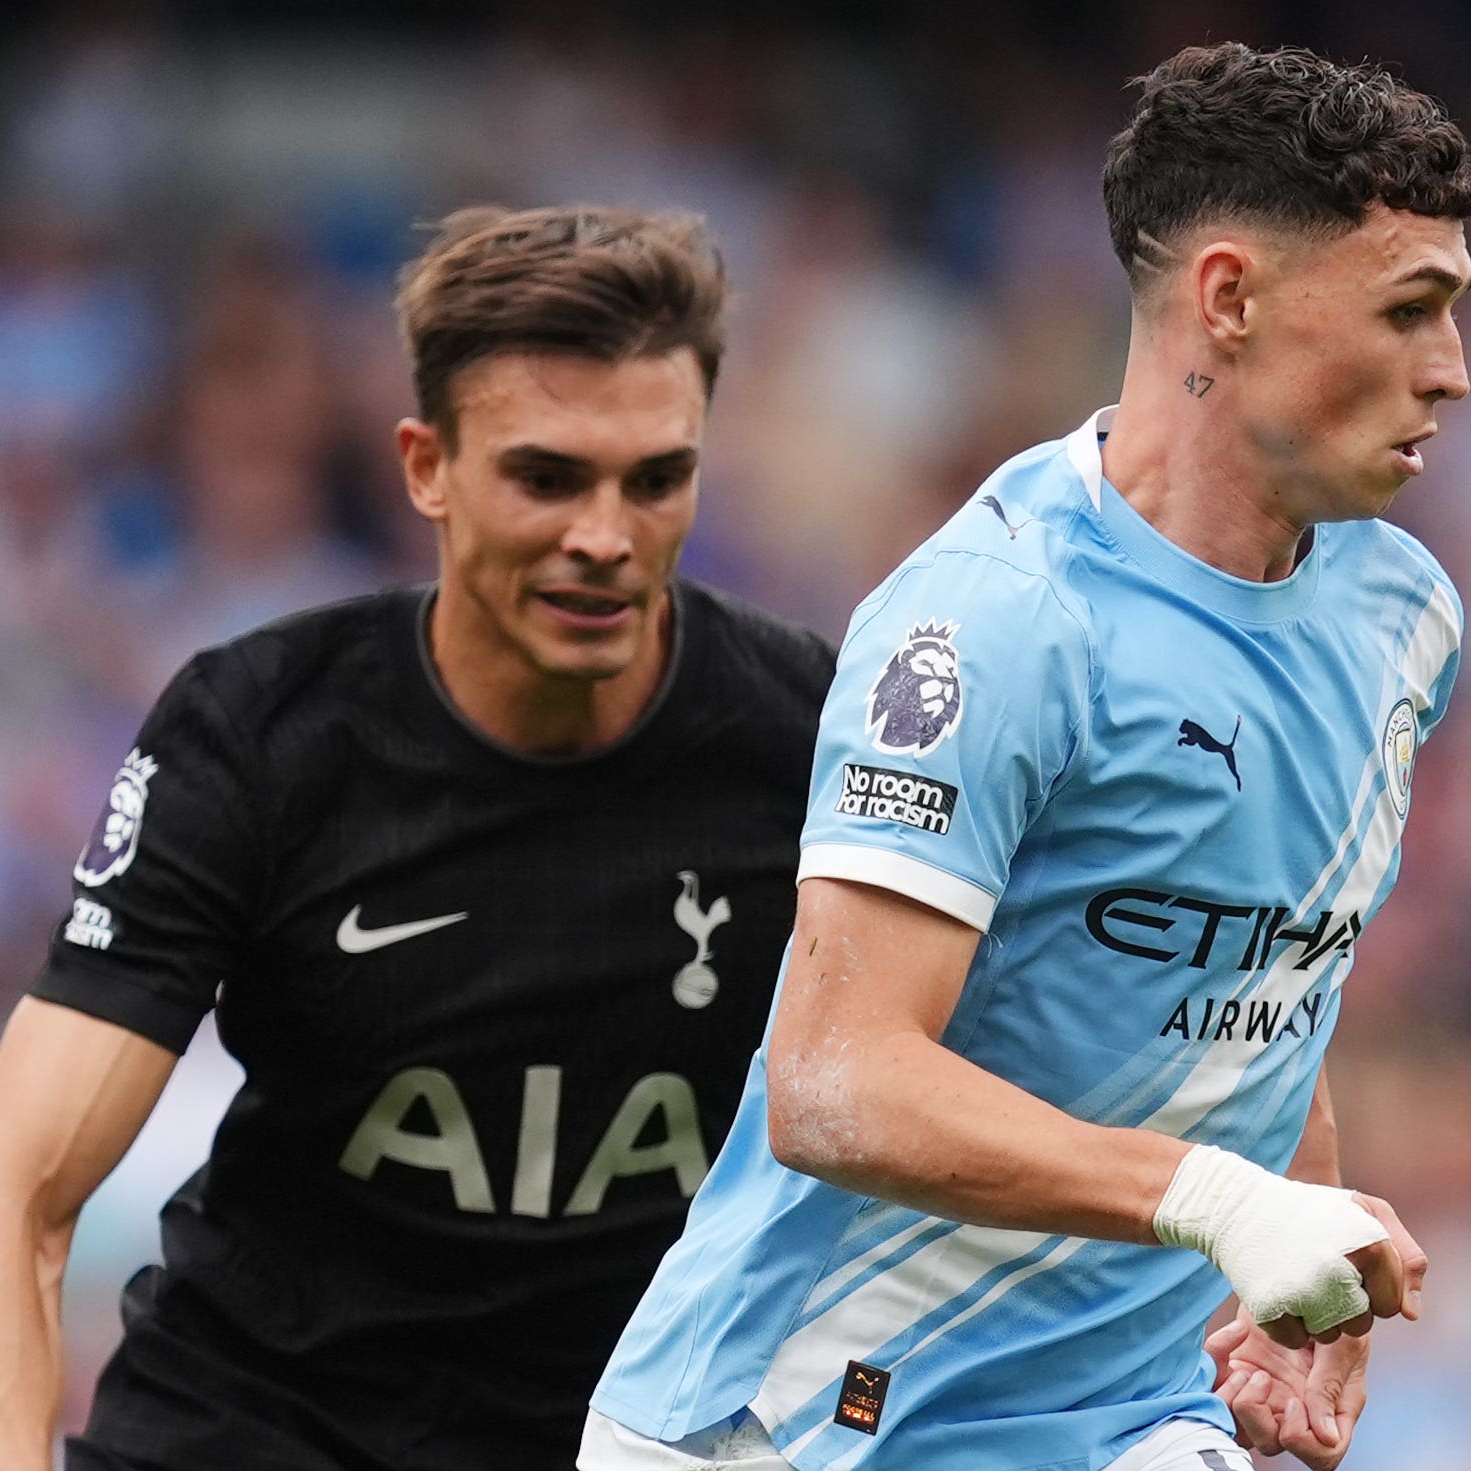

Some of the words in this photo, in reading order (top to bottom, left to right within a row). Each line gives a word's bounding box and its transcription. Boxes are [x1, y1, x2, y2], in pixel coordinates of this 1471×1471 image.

[1184, 371, 1215, 398] 47
[835, 788, 867, 815] for
[865, 796, 950, 834] racism
[843, 765, 870, 793] No
[871, 773, 944, 809] room
[1084, 887, 1362, 971] ETIHA
[1158, 992, 1322, 1043] AIRWAY
[337, 1063, 709, 1219] AIA
